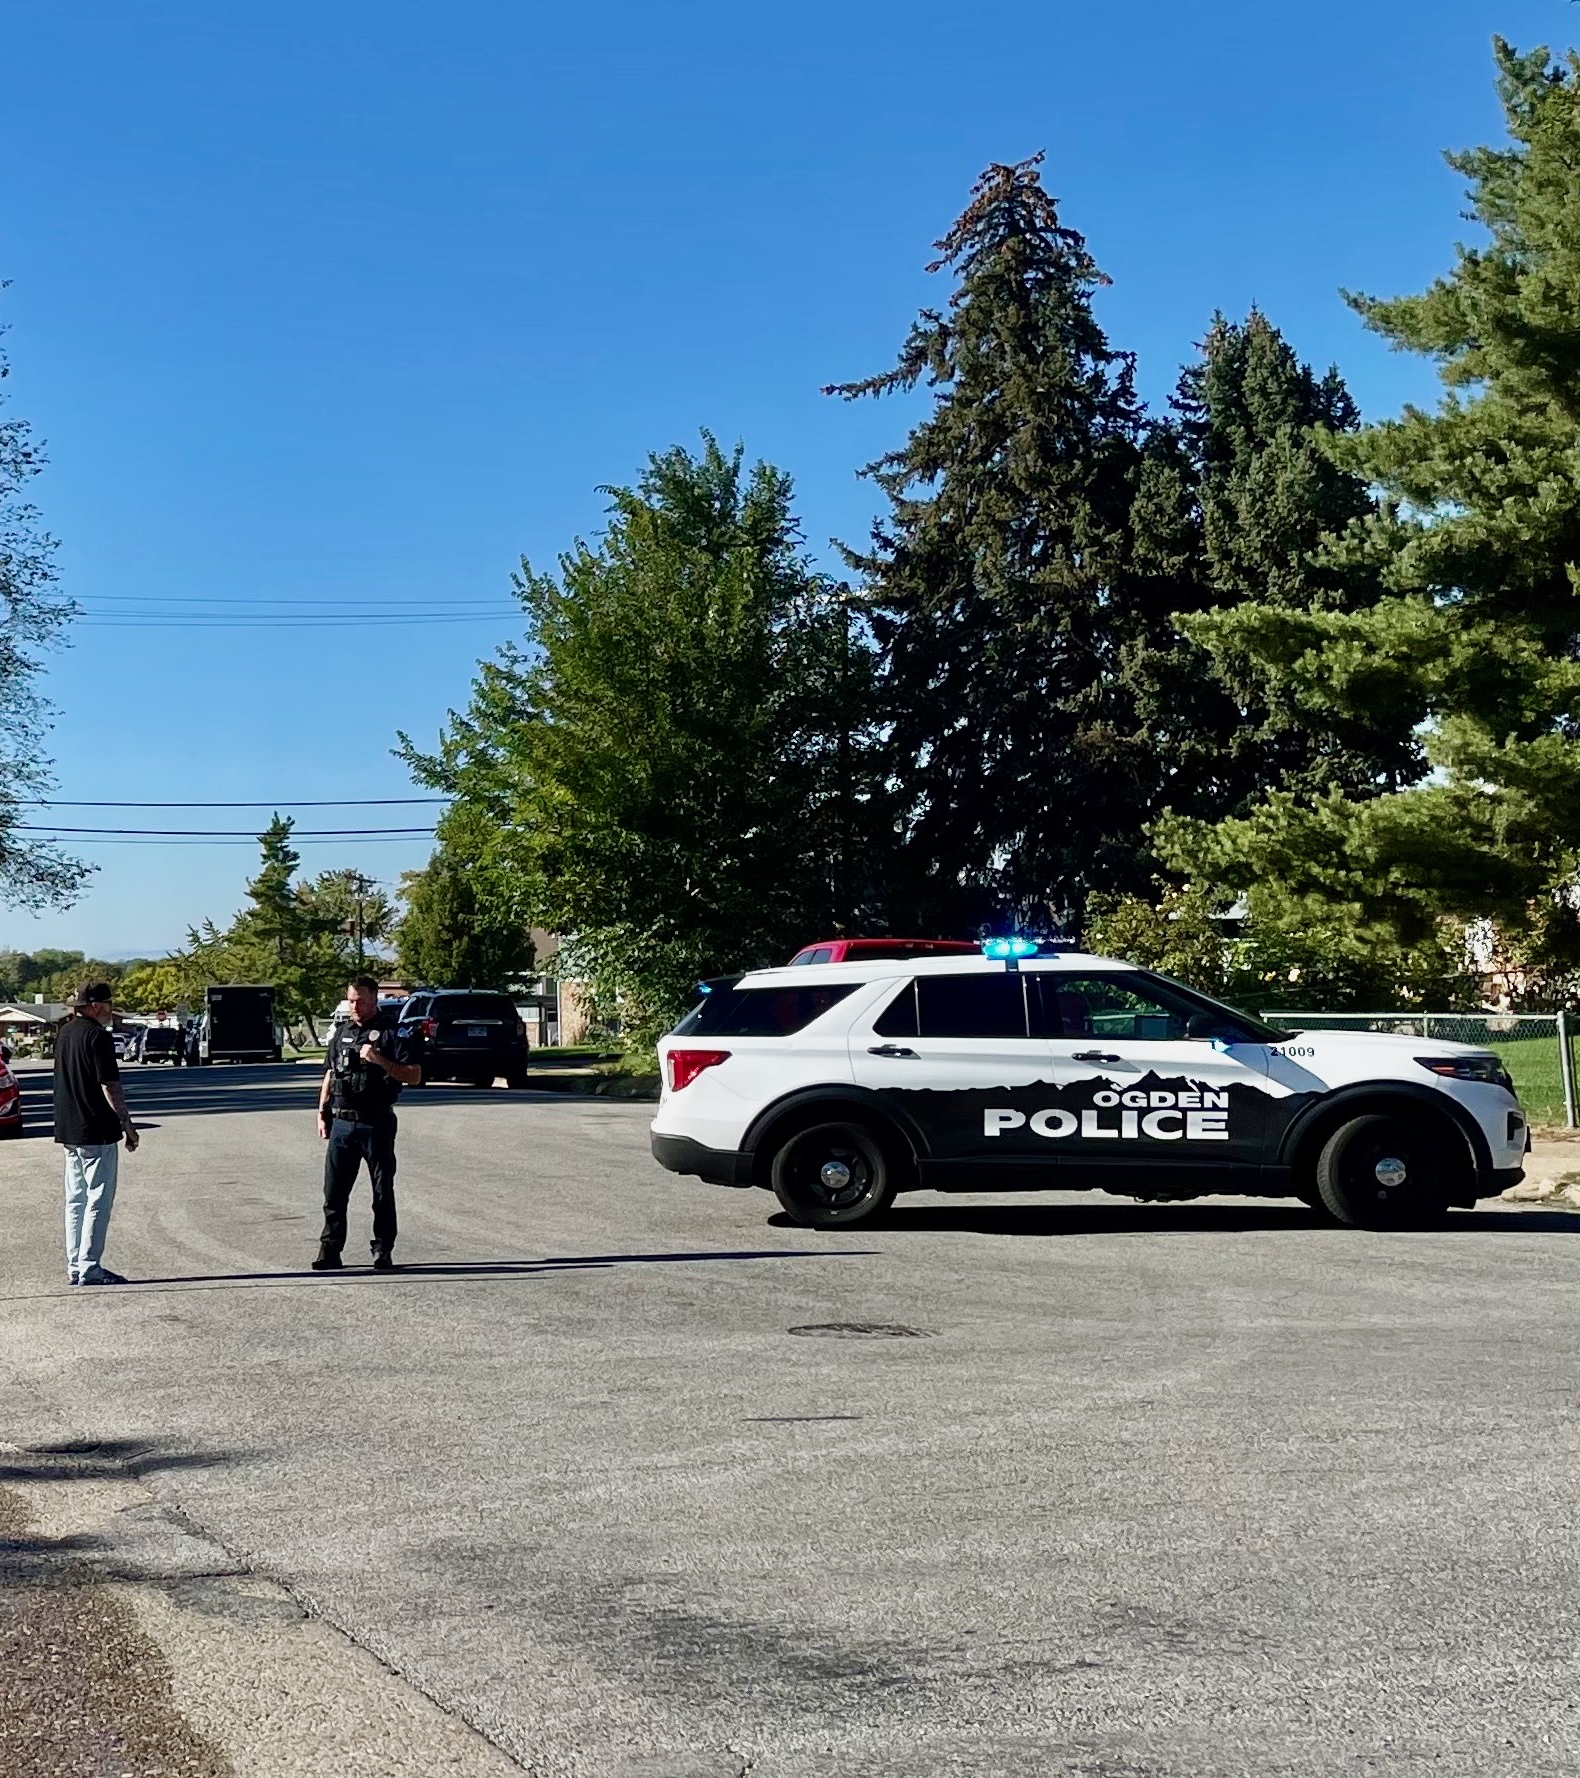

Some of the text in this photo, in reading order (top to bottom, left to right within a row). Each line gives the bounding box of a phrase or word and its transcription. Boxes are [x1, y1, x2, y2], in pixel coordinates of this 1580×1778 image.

[1270, 1046, 1315, 1057] 21009
[1092, 1090, 1229, 1108] OGDEN
[983, 1108, 1230, 1140] POLICE
